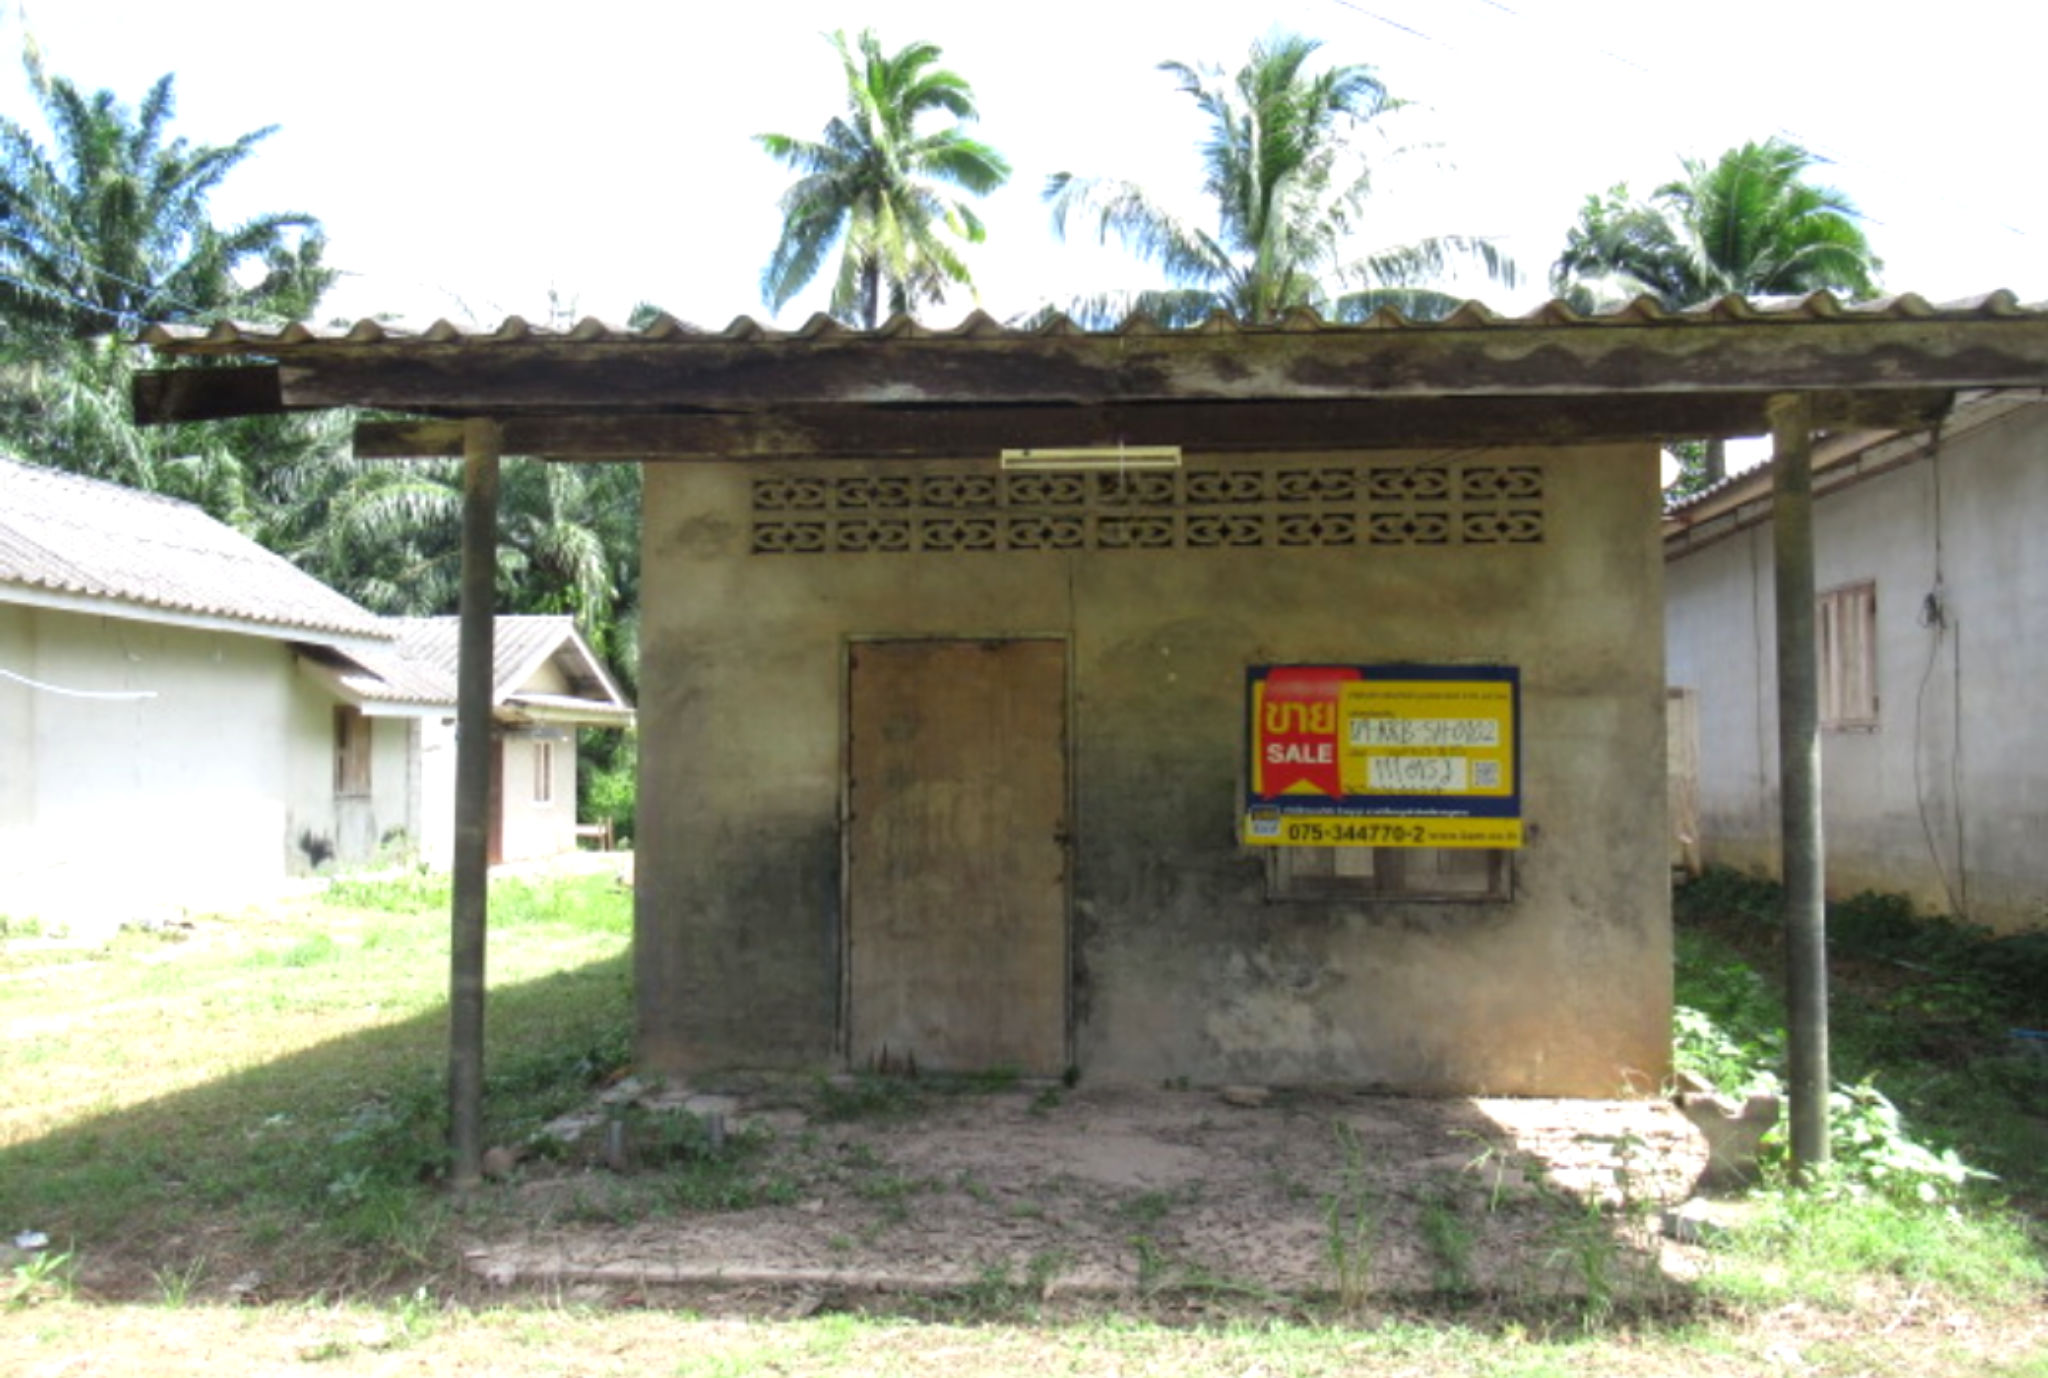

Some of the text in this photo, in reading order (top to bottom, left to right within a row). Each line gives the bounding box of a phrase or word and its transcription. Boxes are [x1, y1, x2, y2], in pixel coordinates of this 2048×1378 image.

[1266, 701, 1335, 735] ขาย
[1266, 743, 1333, 764] SALE
[1288, 823, 1425, 843] 075-344770-2
